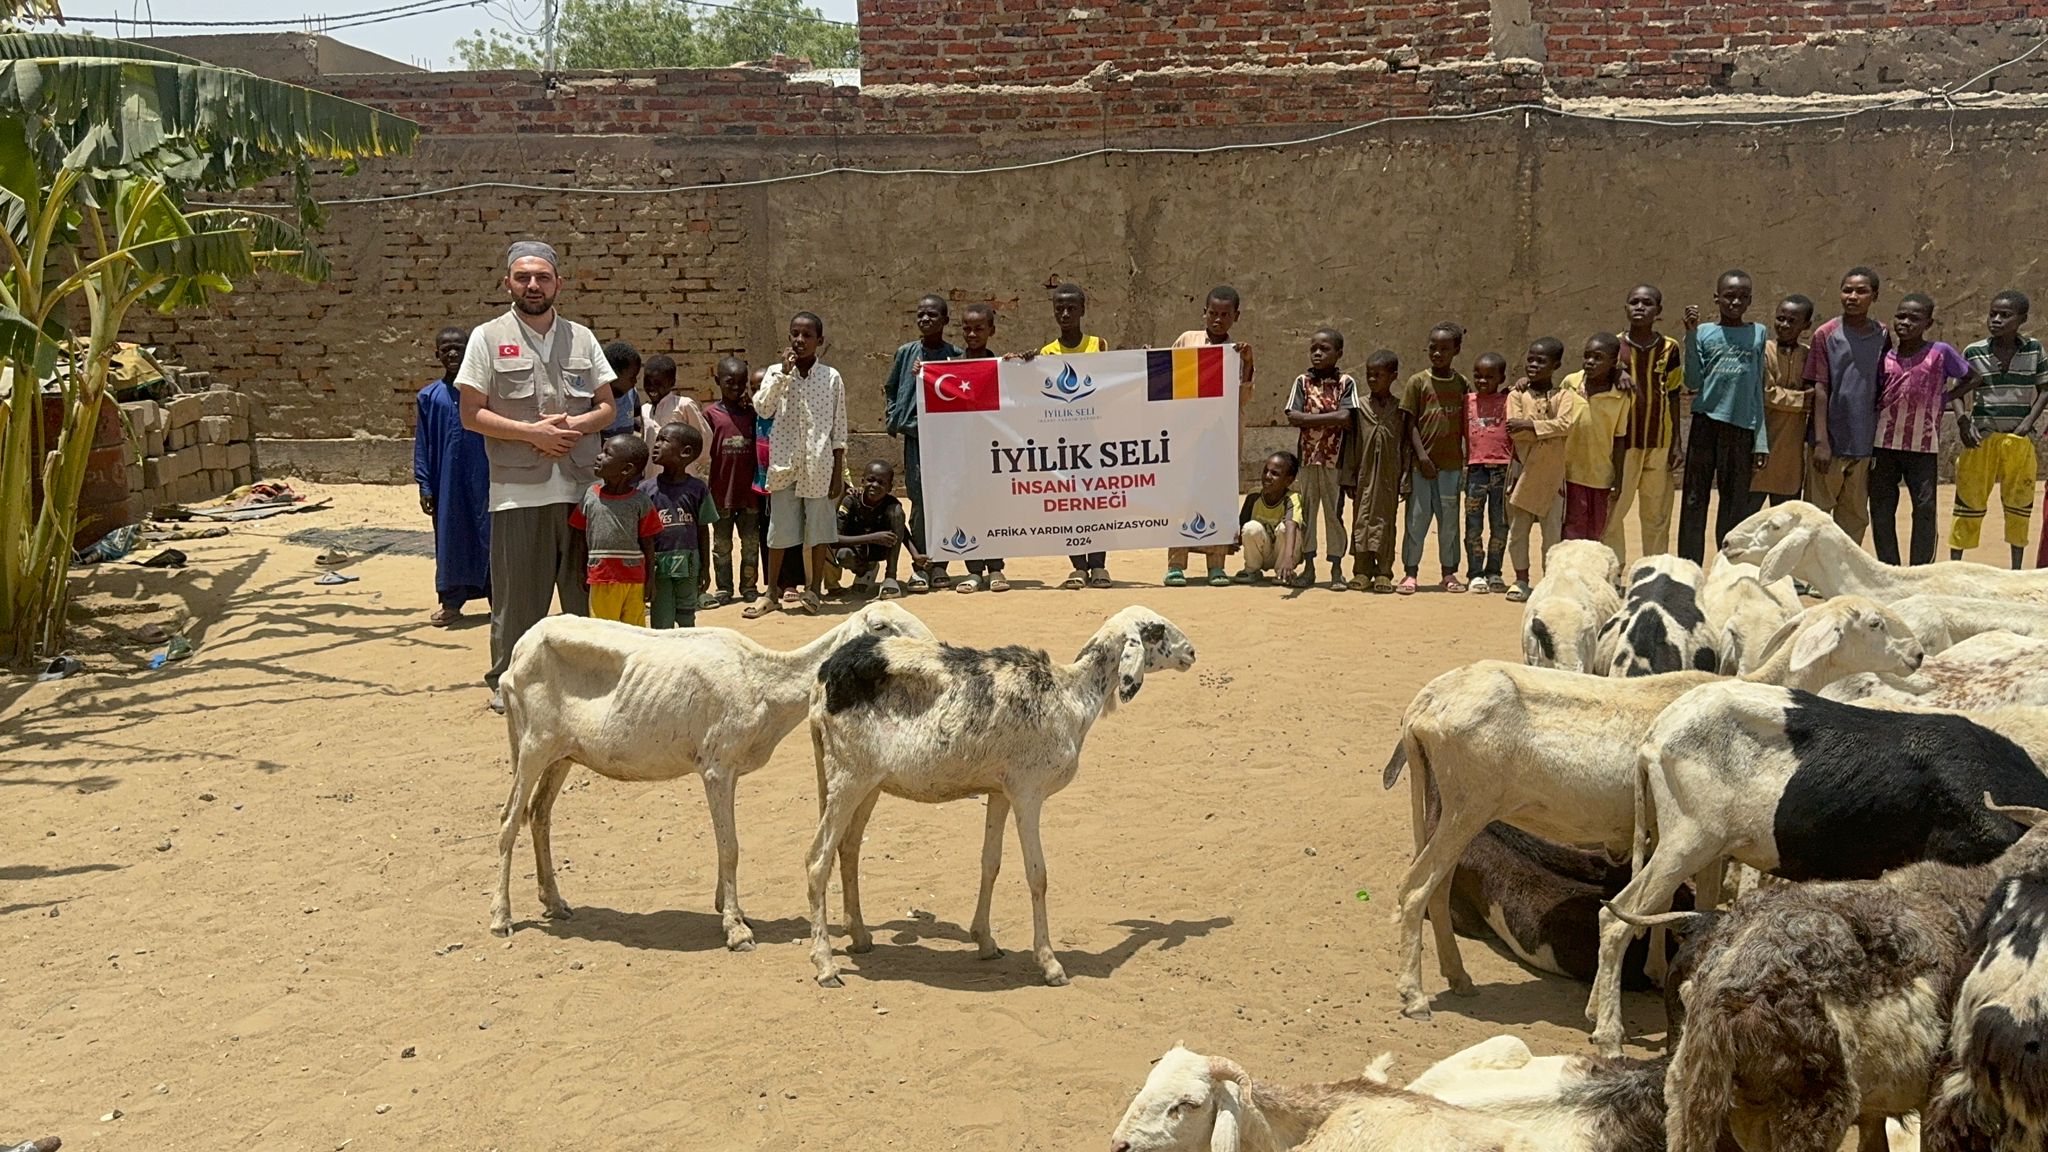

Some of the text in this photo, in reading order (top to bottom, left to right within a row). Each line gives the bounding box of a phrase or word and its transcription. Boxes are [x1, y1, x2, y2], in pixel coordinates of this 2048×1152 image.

[990, 429, 1171, 474] İYİLİK SELİ
[1011, 473, 1155, 495] İNSANİ YARDIM
[1043, 490, 1127, 512] DERNEĞİ
[987, 518, 1169, 537] AFRİKA YARDIM ORGANİZASYONU
[1065, 537, 1092, 546] 2024
